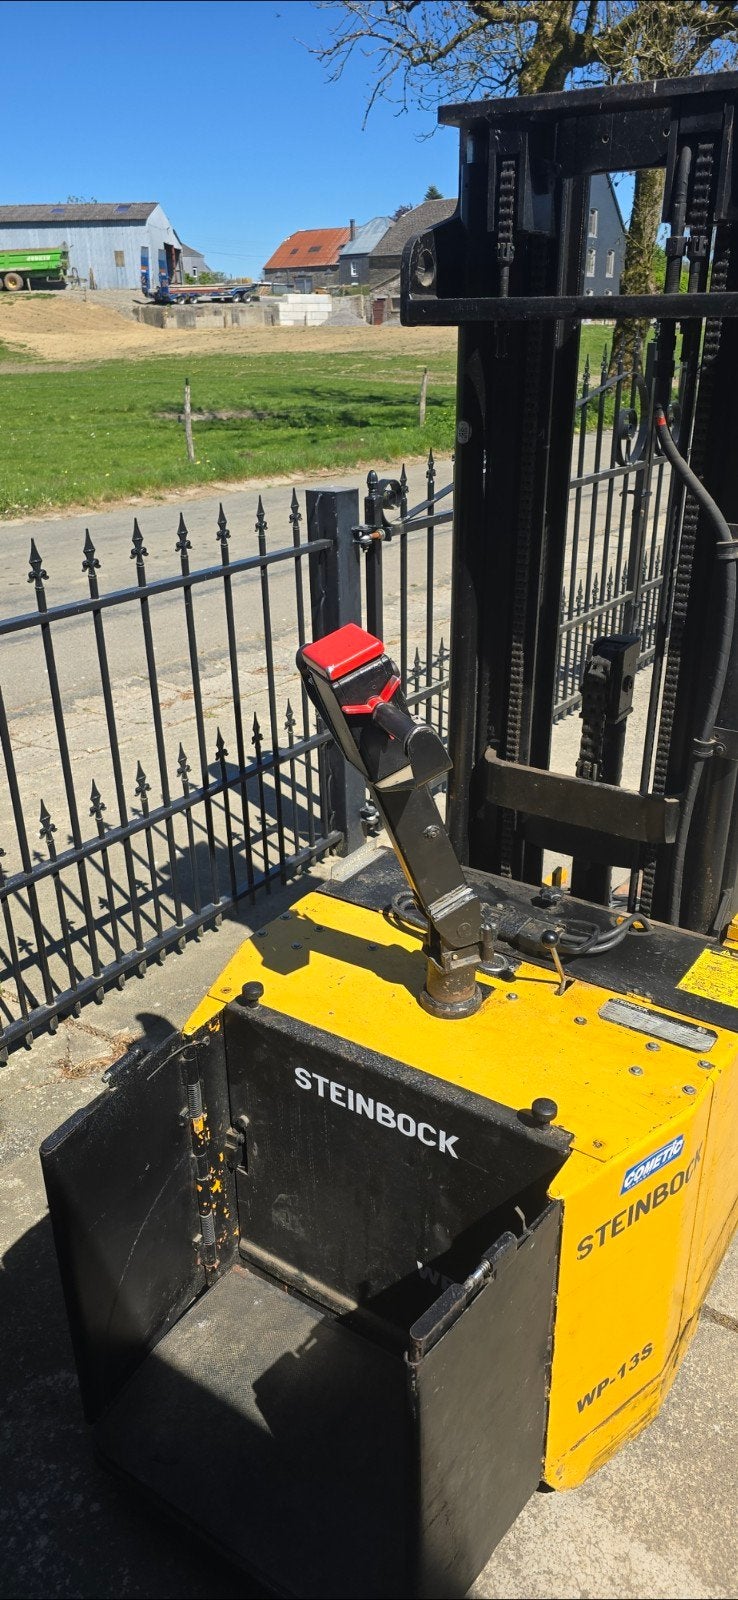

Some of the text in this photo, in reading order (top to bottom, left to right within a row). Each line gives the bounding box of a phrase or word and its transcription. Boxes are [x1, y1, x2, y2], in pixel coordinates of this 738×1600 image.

[294, 1067, 459, 1159] STEINBOCK
[576, 1140, 703, 1260] STEINBOCK
[577, 1342, 653, 1414] WP-13S
